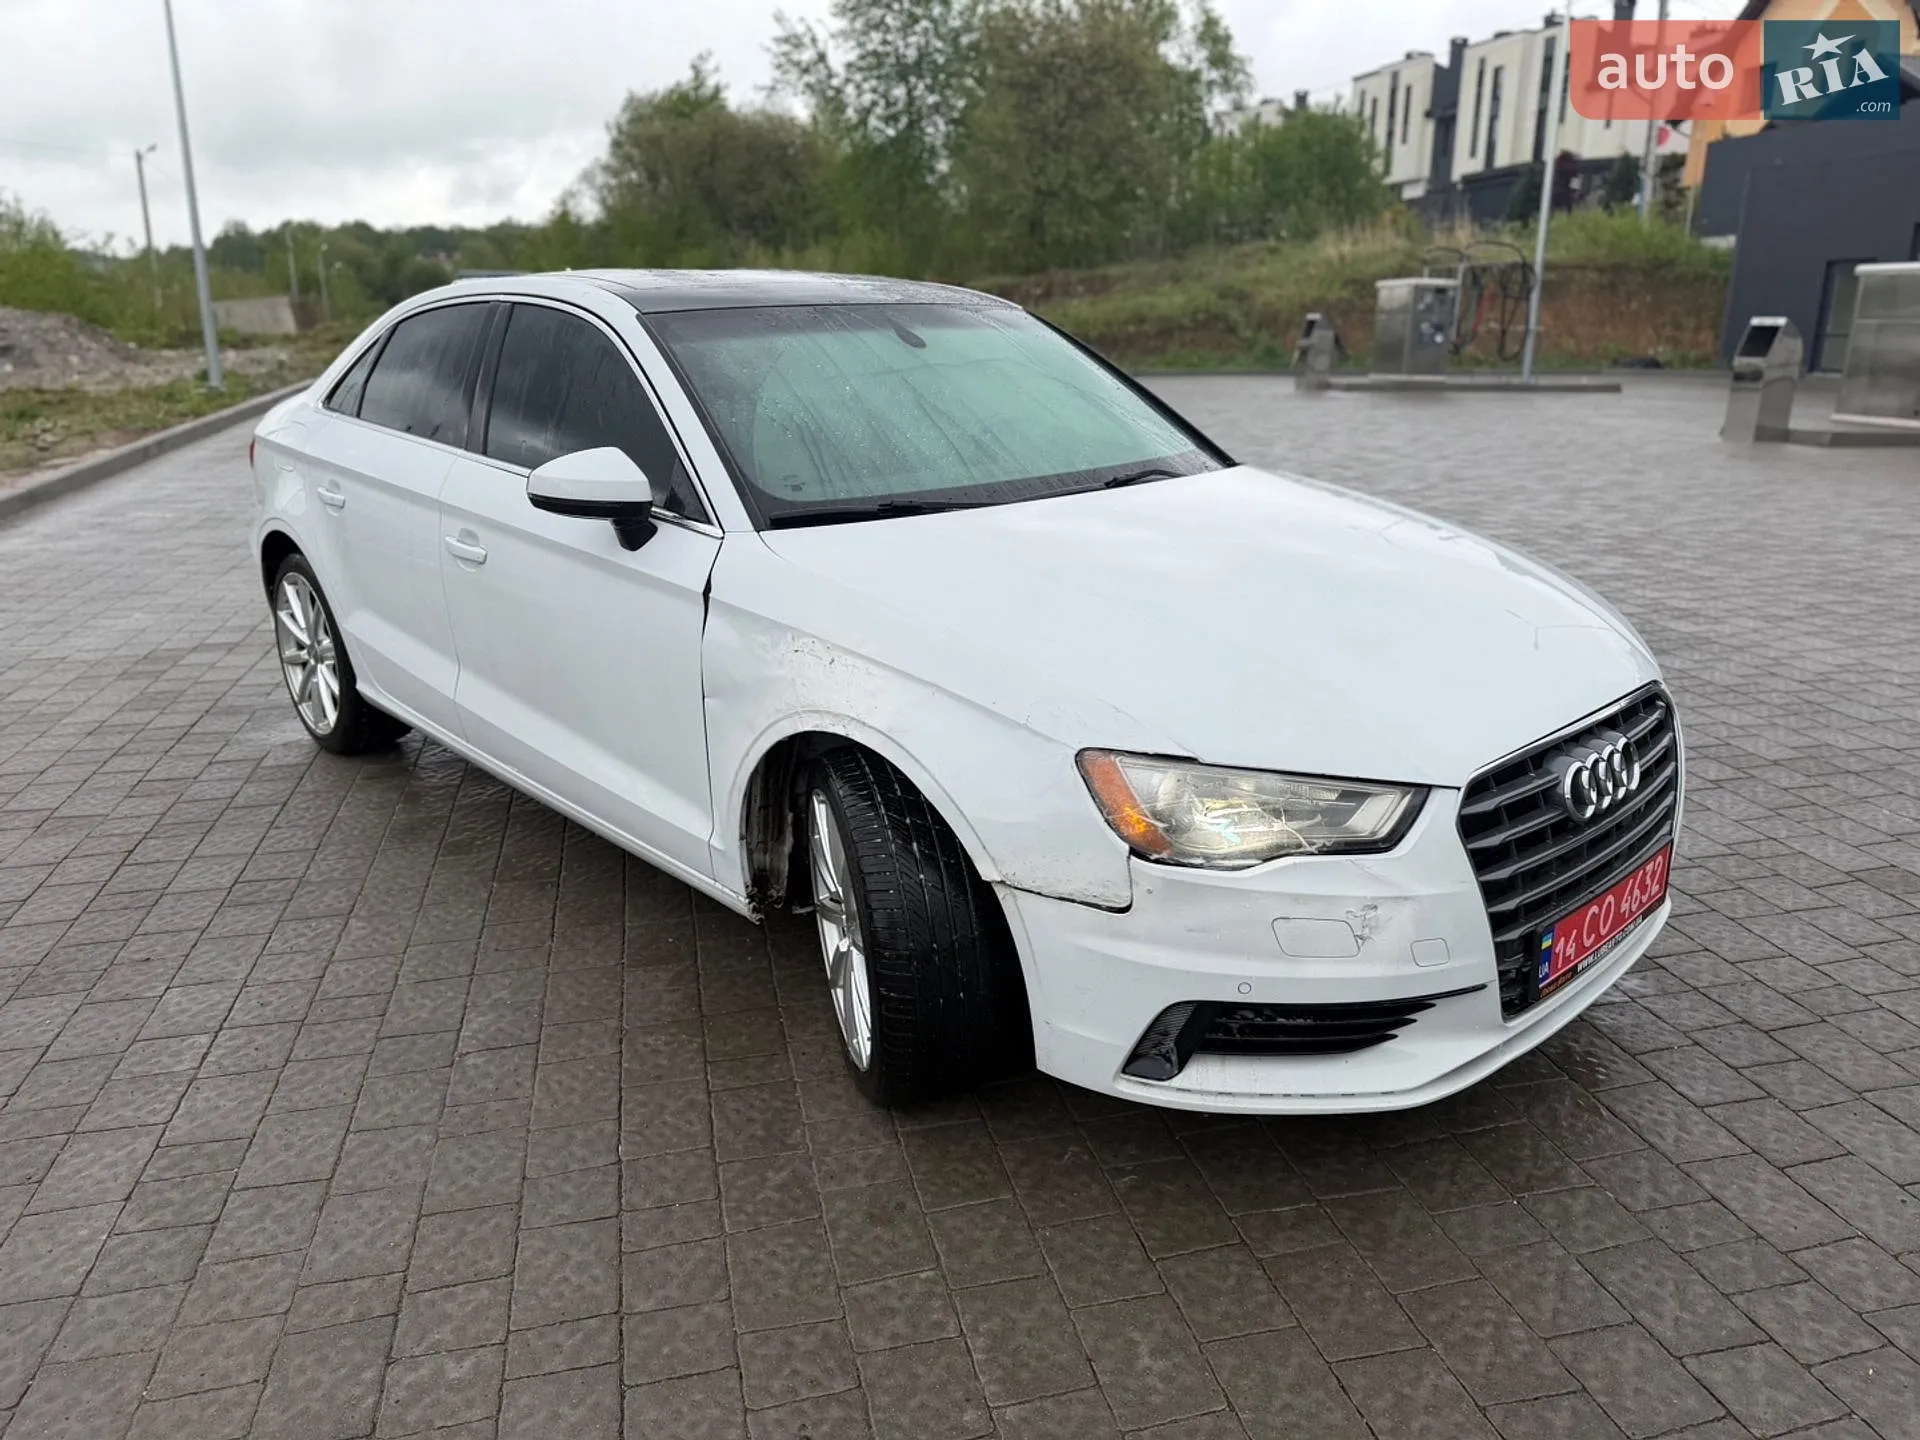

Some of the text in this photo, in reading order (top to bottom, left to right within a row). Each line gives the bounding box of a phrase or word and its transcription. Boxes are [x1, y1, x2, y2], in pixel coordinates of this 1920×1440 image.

[1555, 928, 1577, 969] 14
[1582, 894, 1615, 948] CO
[1620, 855, 1664, 919] 4632
[1539, 962, 1550, 979] UA
